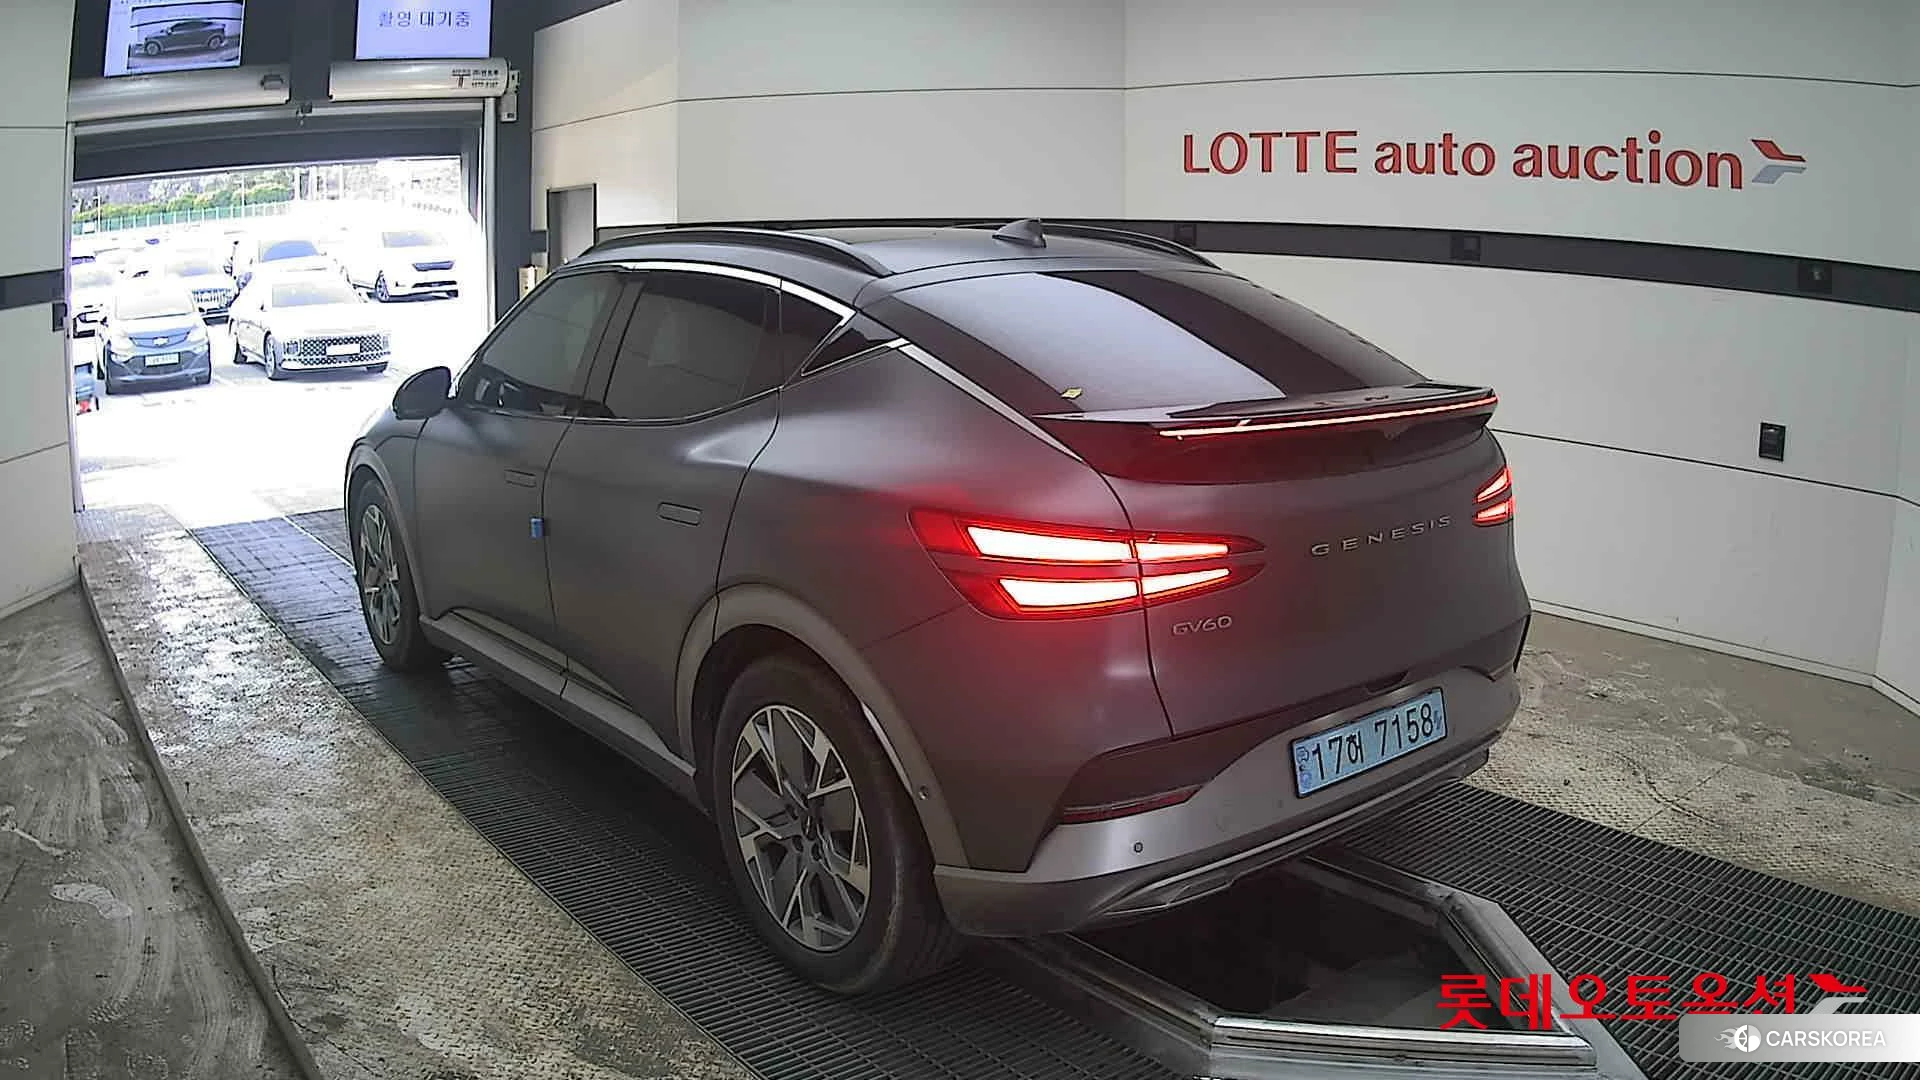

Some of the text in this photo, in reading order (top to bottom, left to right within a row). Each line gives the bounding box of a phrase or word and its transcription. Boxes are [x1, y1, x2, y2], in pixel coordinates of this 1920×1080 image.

[419, 10, 471, 27] 대기중
[1184, 130, 1741, 189] LOTTE auto auction
[1310, 514, 1453, 556] GENESIS
[1172, 615, 1233, 636] GV60
[1311, 731, 1365, 781] 17허
[1373, 703, 1434, 756] 7158
